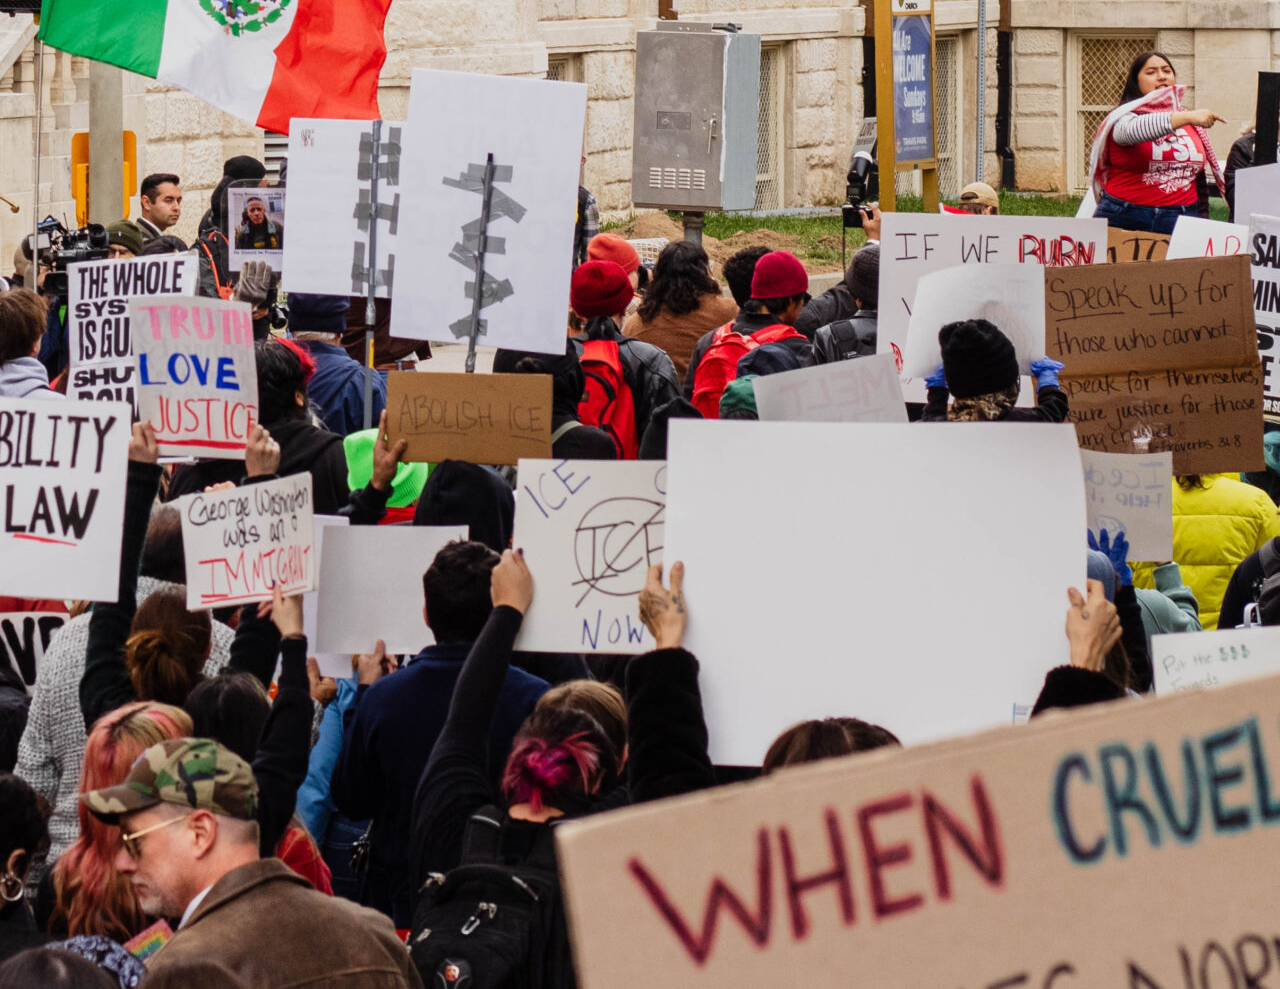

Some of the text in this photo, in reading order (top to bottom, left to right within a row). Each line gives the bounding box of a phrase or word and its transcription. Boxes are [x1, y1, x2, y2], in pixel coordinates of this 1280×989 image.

[893, 53, 926, 83] WELCOME
[903, 85, 926, 111] Sundays
[1151, 136, 1204, 162] PSL
[895, 232, 940, 261] IF
[961, 234, 1000, 263] WE
[1251, 232, 1280, 270] SA
[77, 260, 186, 301] THE WHOLE
[1148, 281, 1188, 319] up
[1194, 268, 1235, 306] for
[74, 298, 130, 320] SYS
[138, 303, 255, 349] TRUTH
[78, 316, 134, 361] IS GU
[1053, 318, 1232, 356] those who cannot
[138, 352, 240, 392] LOVE
[1127, 370, 1155, 395] for
[147, 395, 259, 441] JUSTICE
[398, 393, 545, 433] ABOLISH ICE
[1180, 394, 1202, 418] for
[1208, 392, 1255, 415] those
[524, 459, 591, 519] ICE
[5, 484, 100, 541] LAW
[187, 495, 251, 527] George
[223, 518, 286, 548] was an
[581, 609, 646, 651] NOW
[1161, 654, 1188, 676] Put
[626, 771, 1006, 970] WHEN
